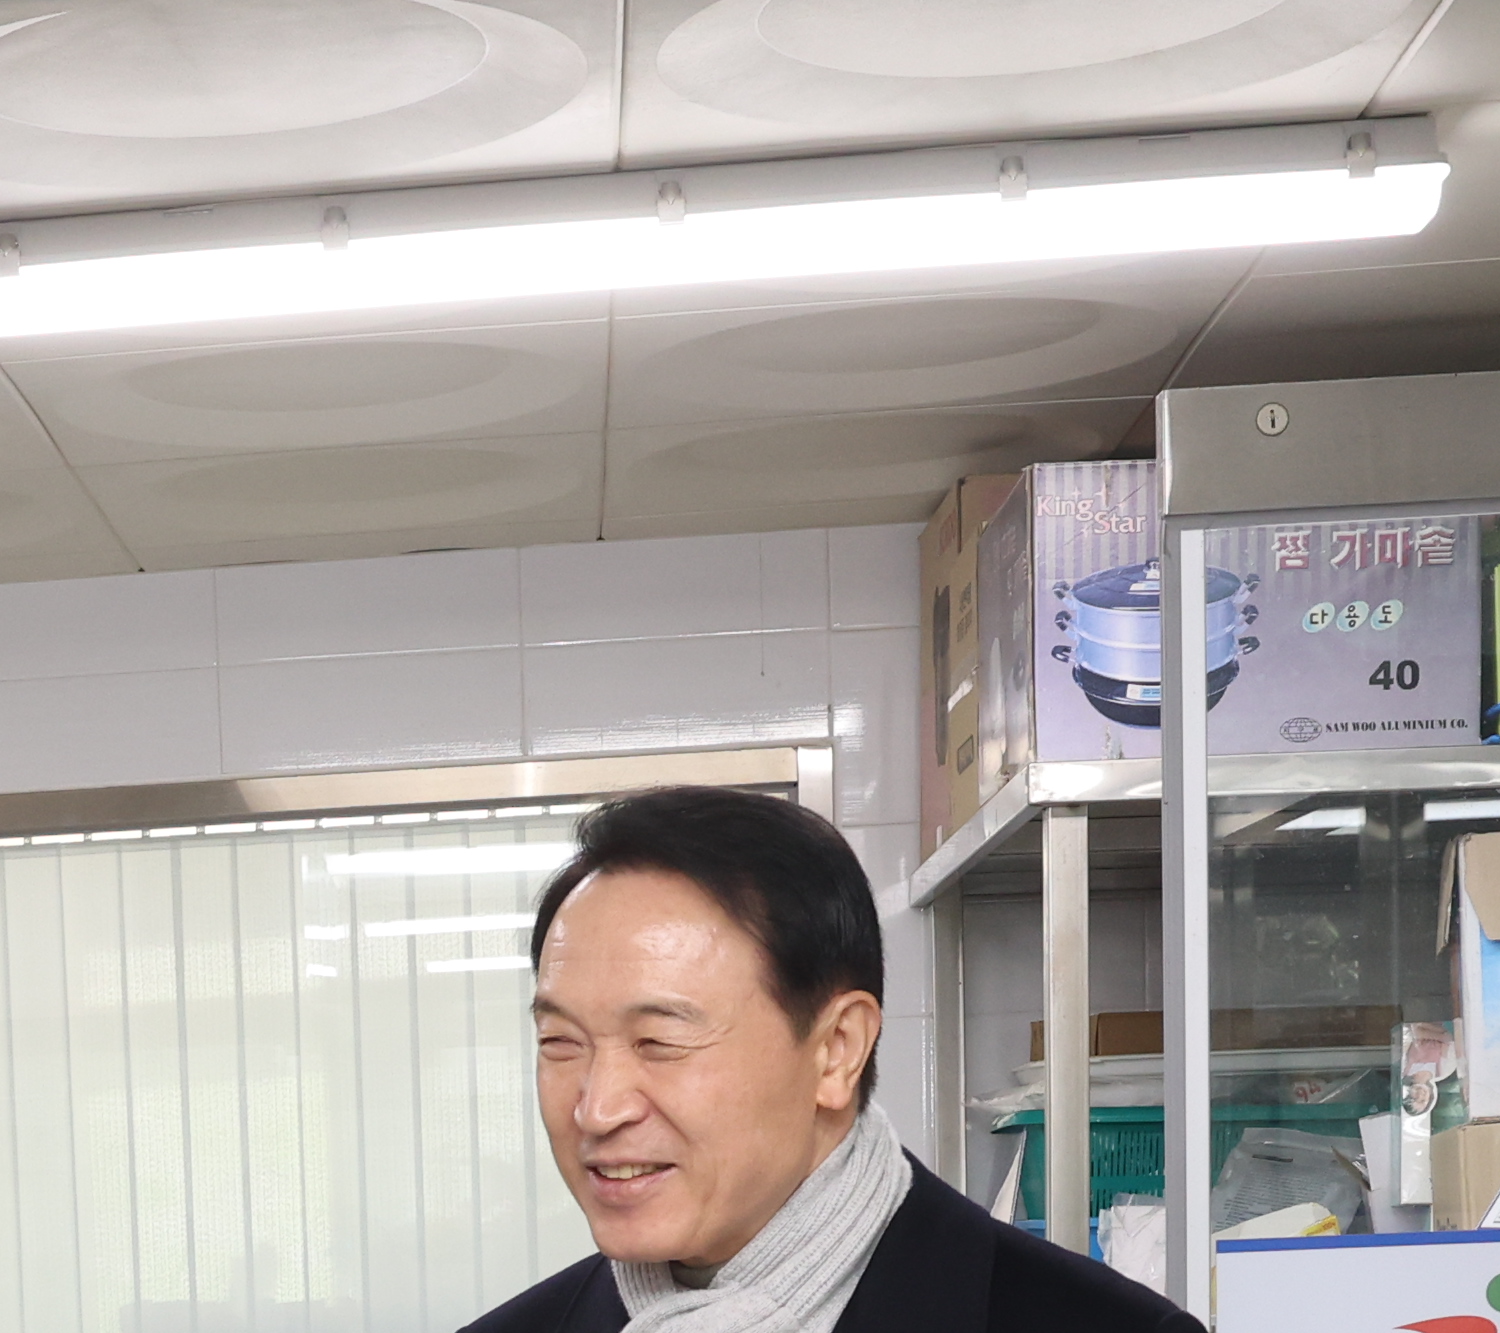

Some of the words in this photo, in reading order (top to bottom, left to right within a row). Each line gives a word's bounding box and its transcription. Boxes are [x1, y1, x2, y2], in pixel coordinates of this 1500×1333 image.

[1036, 494, 1096, 523] King
[1093, 509, 1148, 535] Star
[1271, 529, 1312, 572] 찜
[1368, 659, 1421, 691] 40
[1325, 721, 1351, 733] SAM
[1352, 720, 1377, 732] WOO
[1449, 718, 1469, 730] CO.
